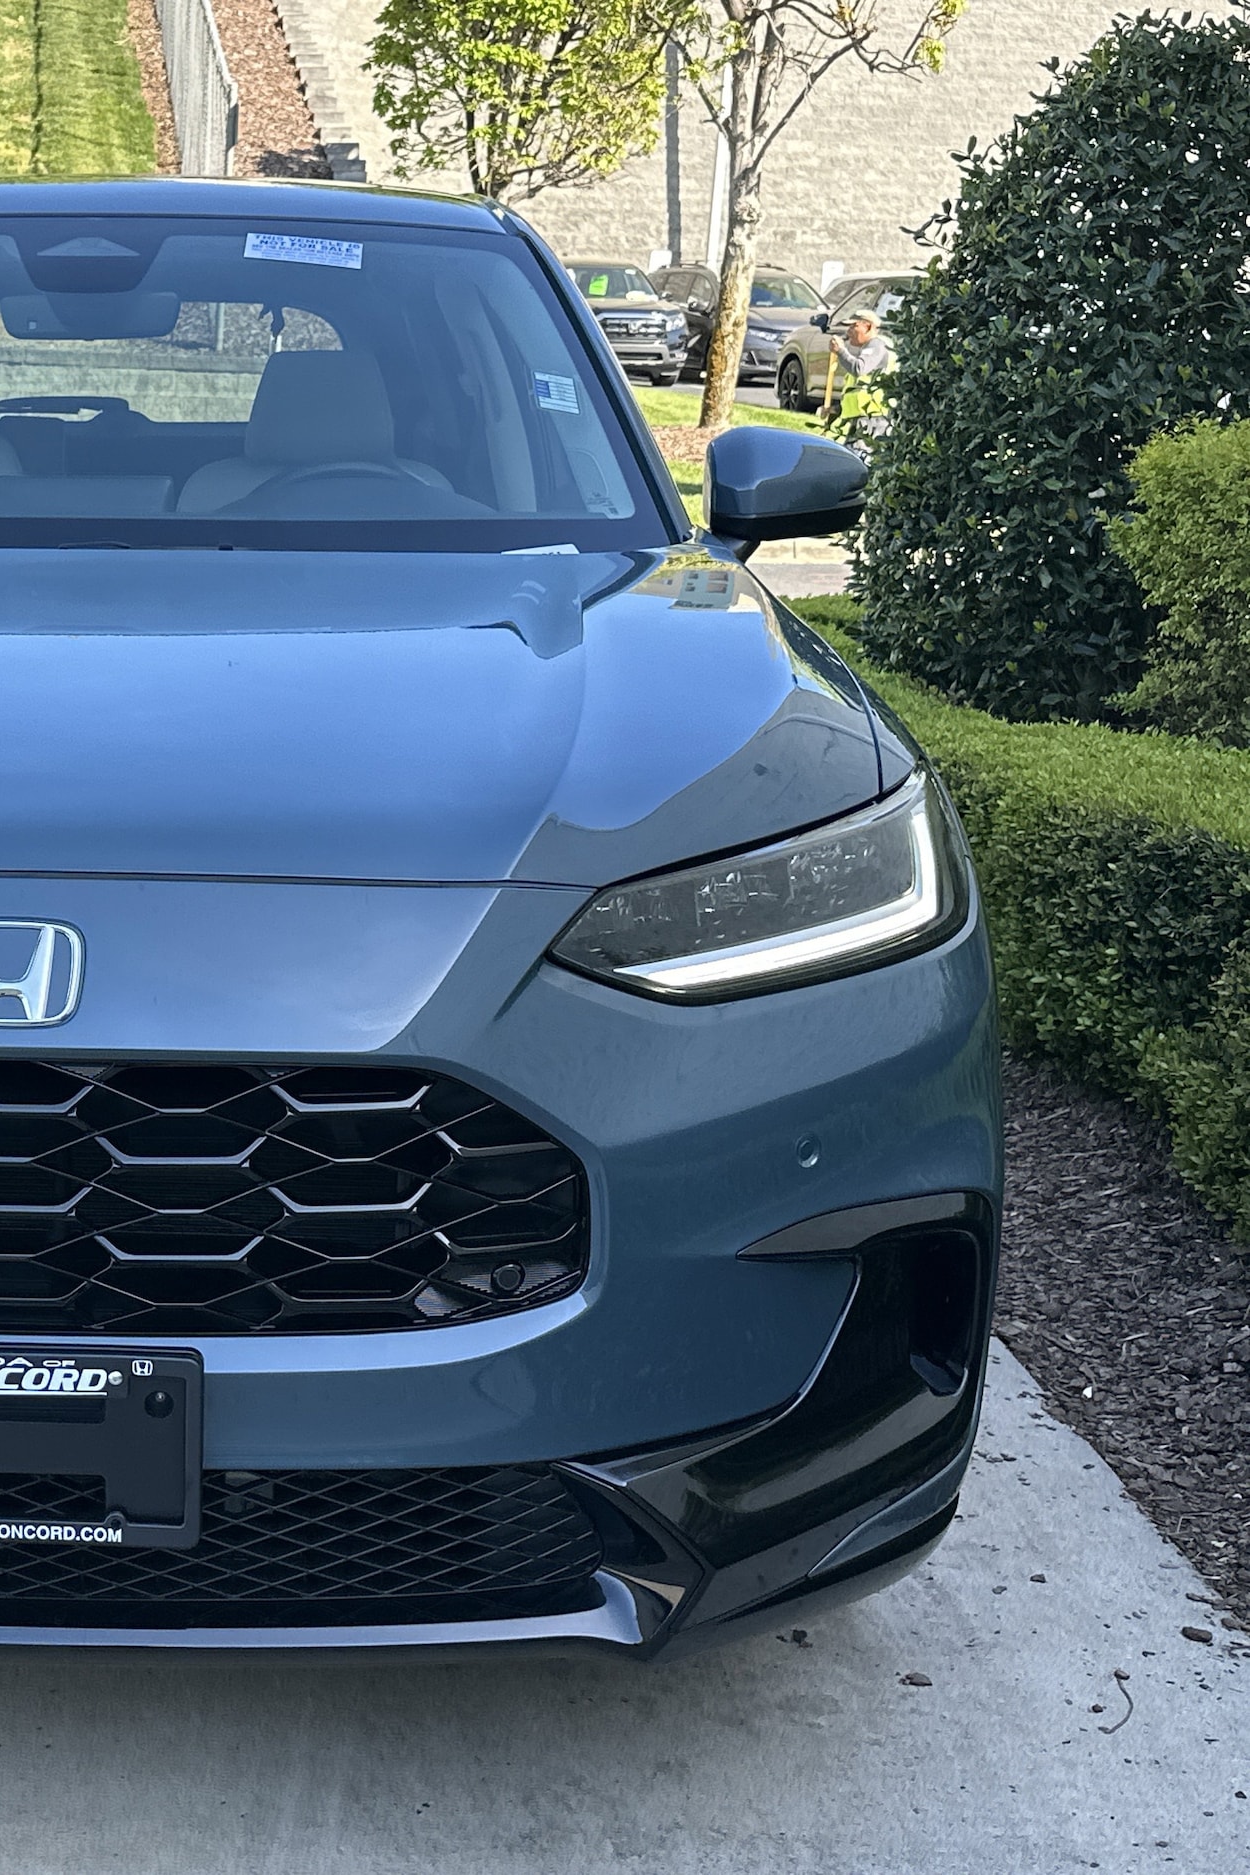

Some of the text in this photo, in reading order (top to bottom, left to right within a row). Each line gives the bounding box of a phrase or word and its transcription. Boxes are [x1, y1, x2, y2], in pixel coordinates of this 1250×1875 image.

[288, 237, 344, 247] VEHICLE
[290, 241, 317, 249] FOR
[321, 244, 354, 254] SALE
[42, 1359, 76, 1368] OF
